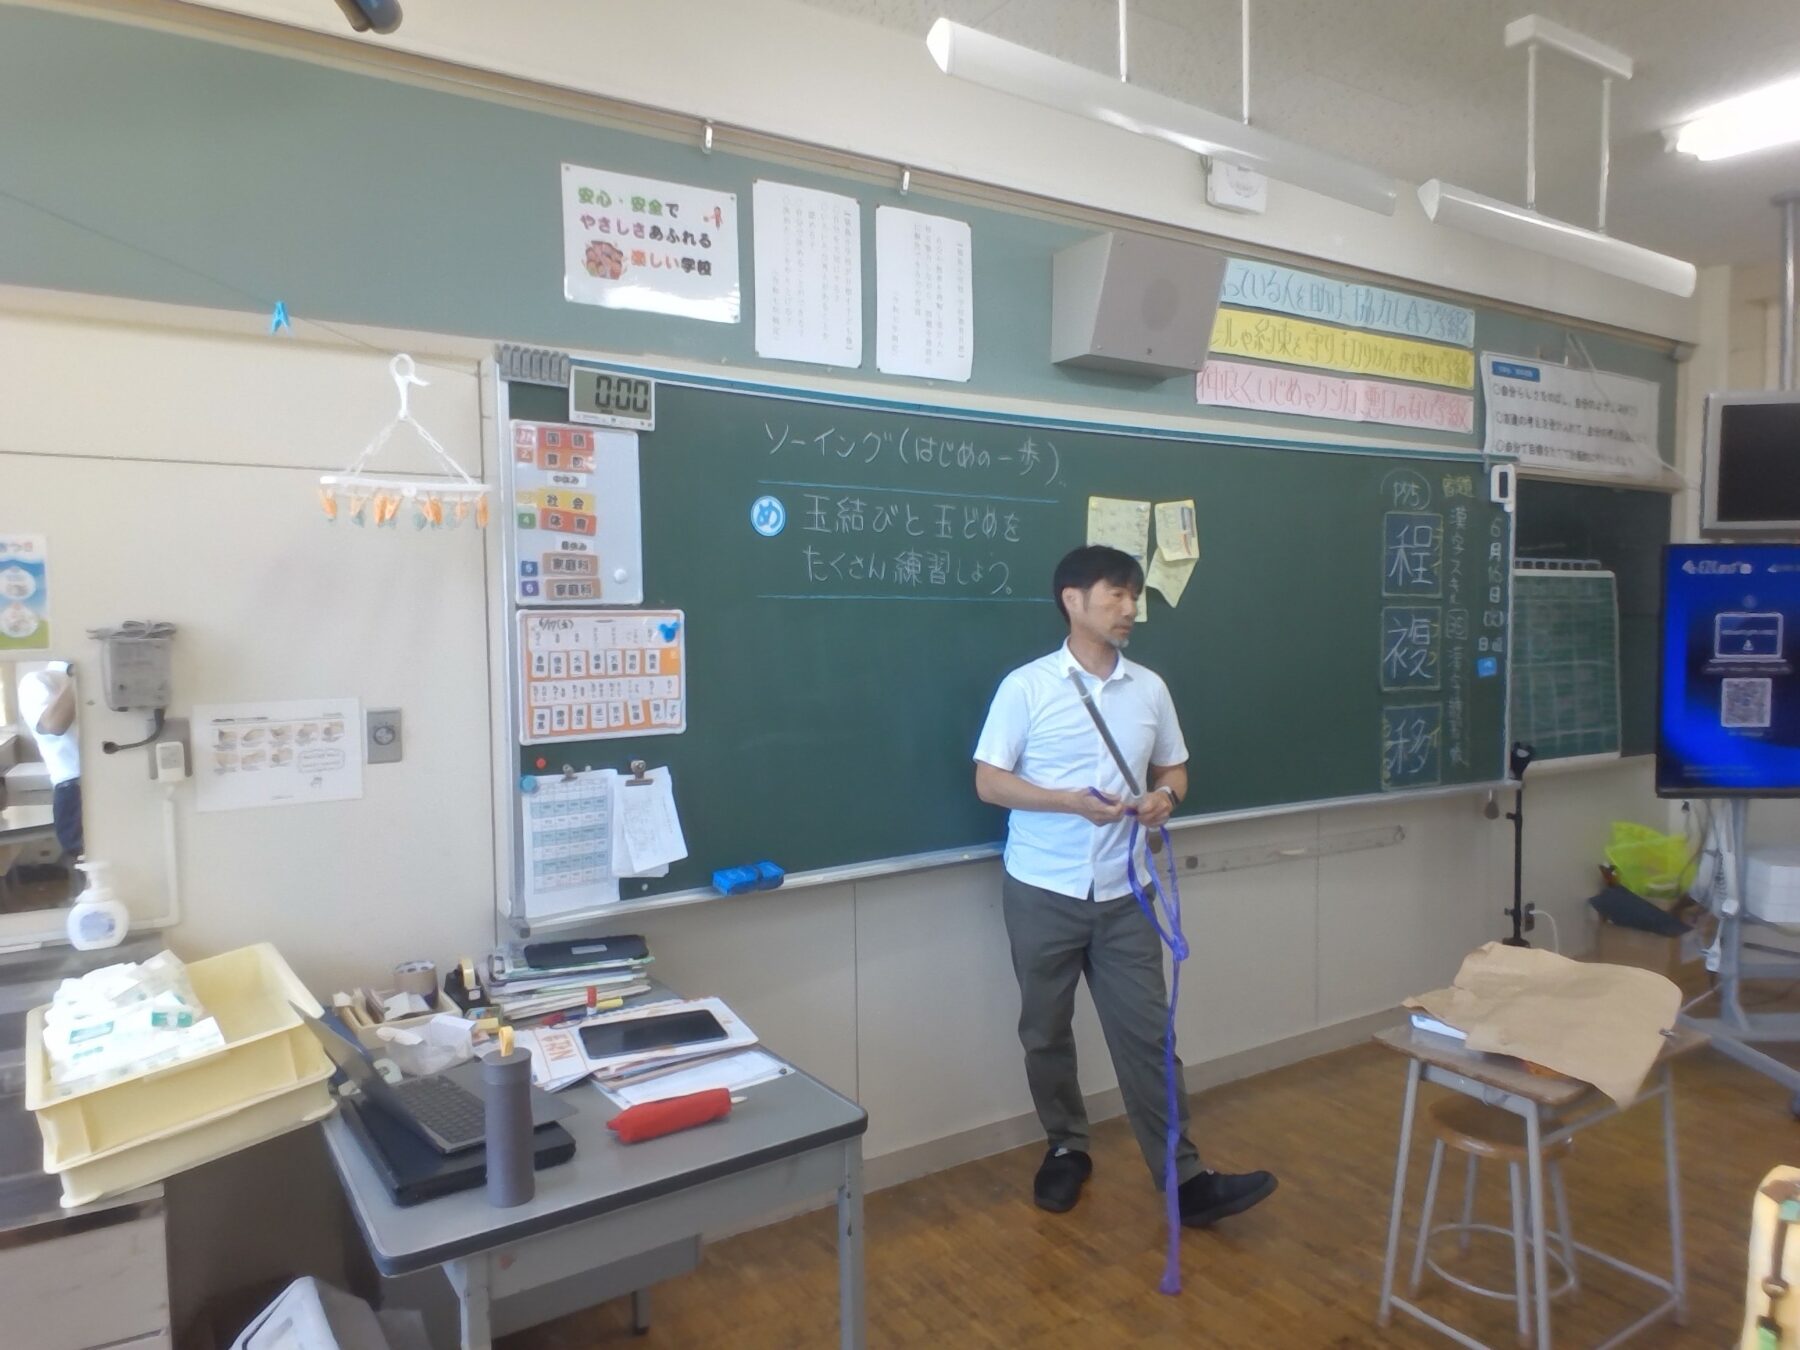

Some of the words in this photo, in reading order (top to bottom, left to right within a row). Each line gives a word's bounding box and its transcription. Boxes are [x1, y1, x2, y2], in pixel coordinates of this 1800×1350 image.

[577, 186, 680, 219] 安心・安全で
[579, 213, 713, 249] やさしさあふれる
[630, 248, 713, 277] 楽しい学校
[596, 374, 649, 413] 0:00
[546, 494, 585, 510] 社会
[756, 500, 781, 528] め
[802, 492, 1021, 543] 玉結びと玉どめを
[552, 558, 589, 571] 家庭科
[1388, 525, 1434, 587] 程
[555, 584, 592, 596] 家庭科
[1384, 614, 1434, 680] 複
[1389, 716, 1432, 775] 移
